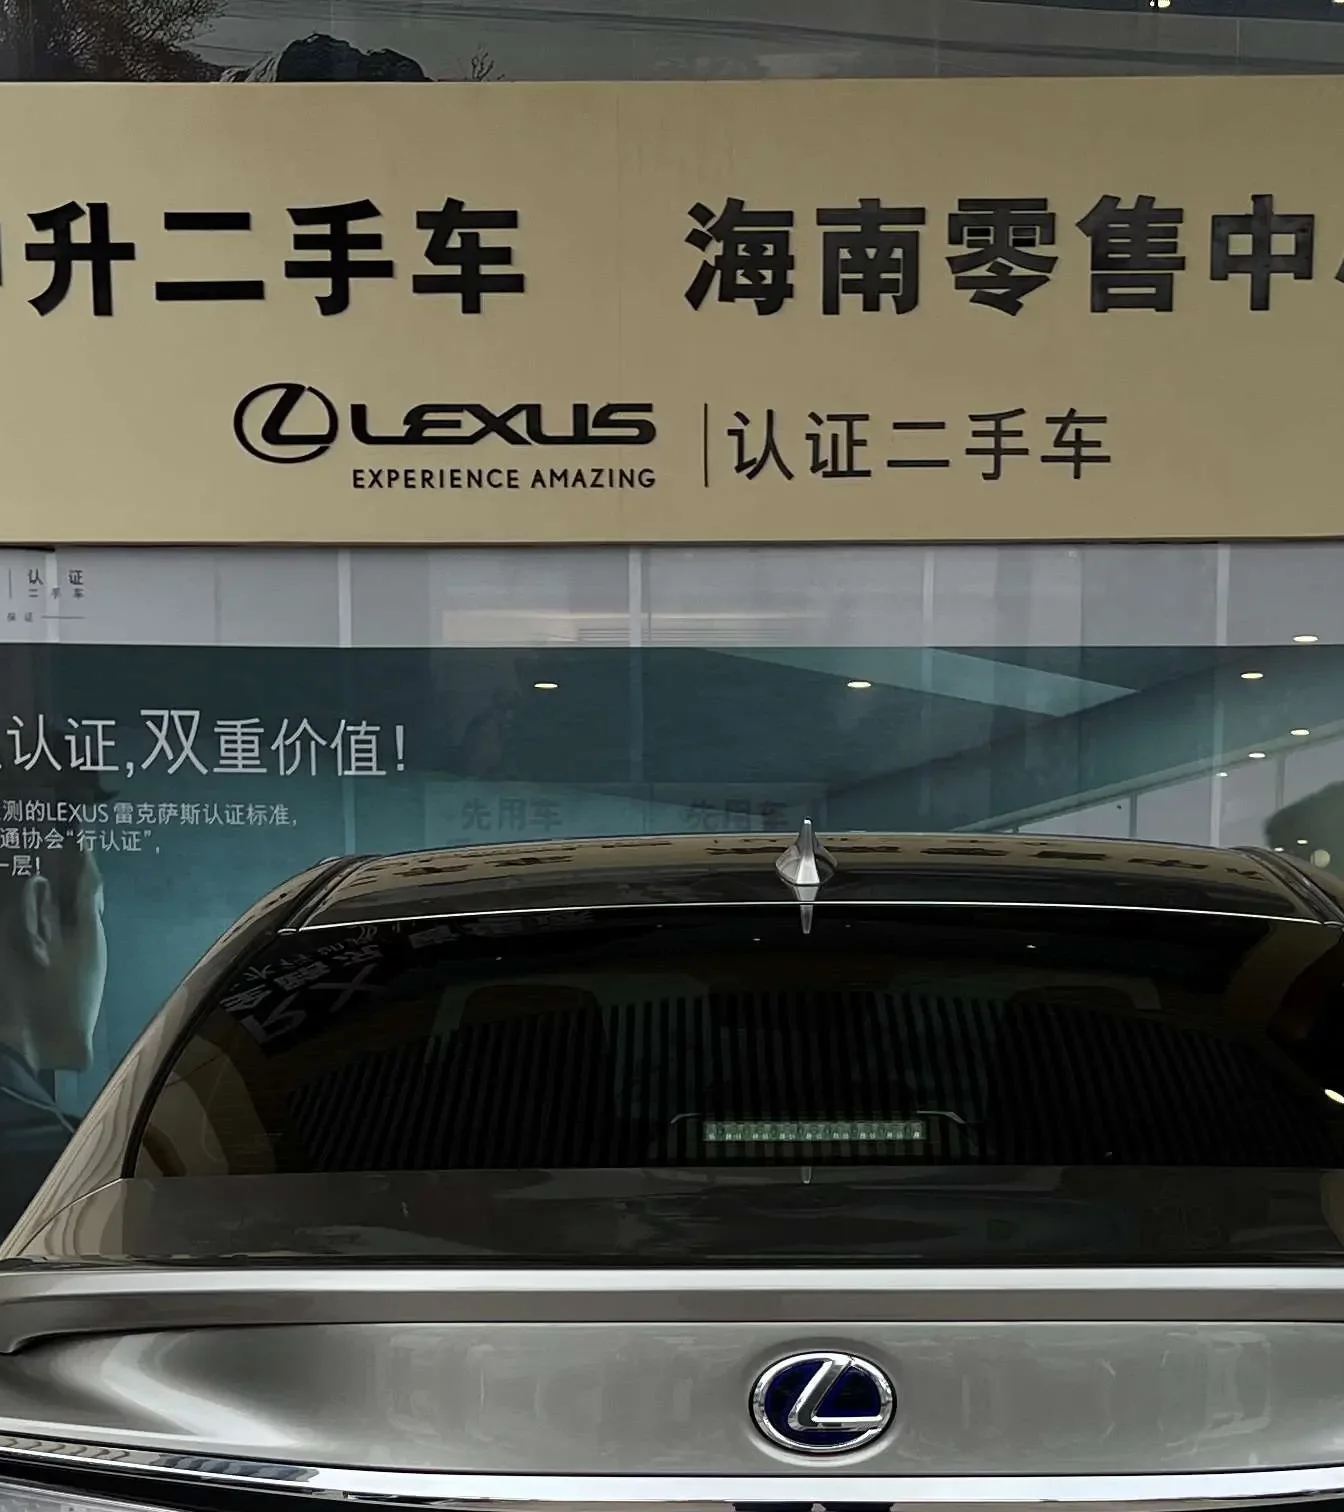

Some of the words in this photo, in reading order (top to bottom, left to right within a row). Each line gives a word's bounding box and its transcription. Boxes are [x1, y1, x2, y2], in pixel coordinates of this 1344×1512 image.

[350, 402, 657, 446] LEXUS
[726, 406, 1113, 482] 认证二手车
[352, 468, 520, 489] EXPERIENCE
[530, 468, 656, 489] AMAZING
